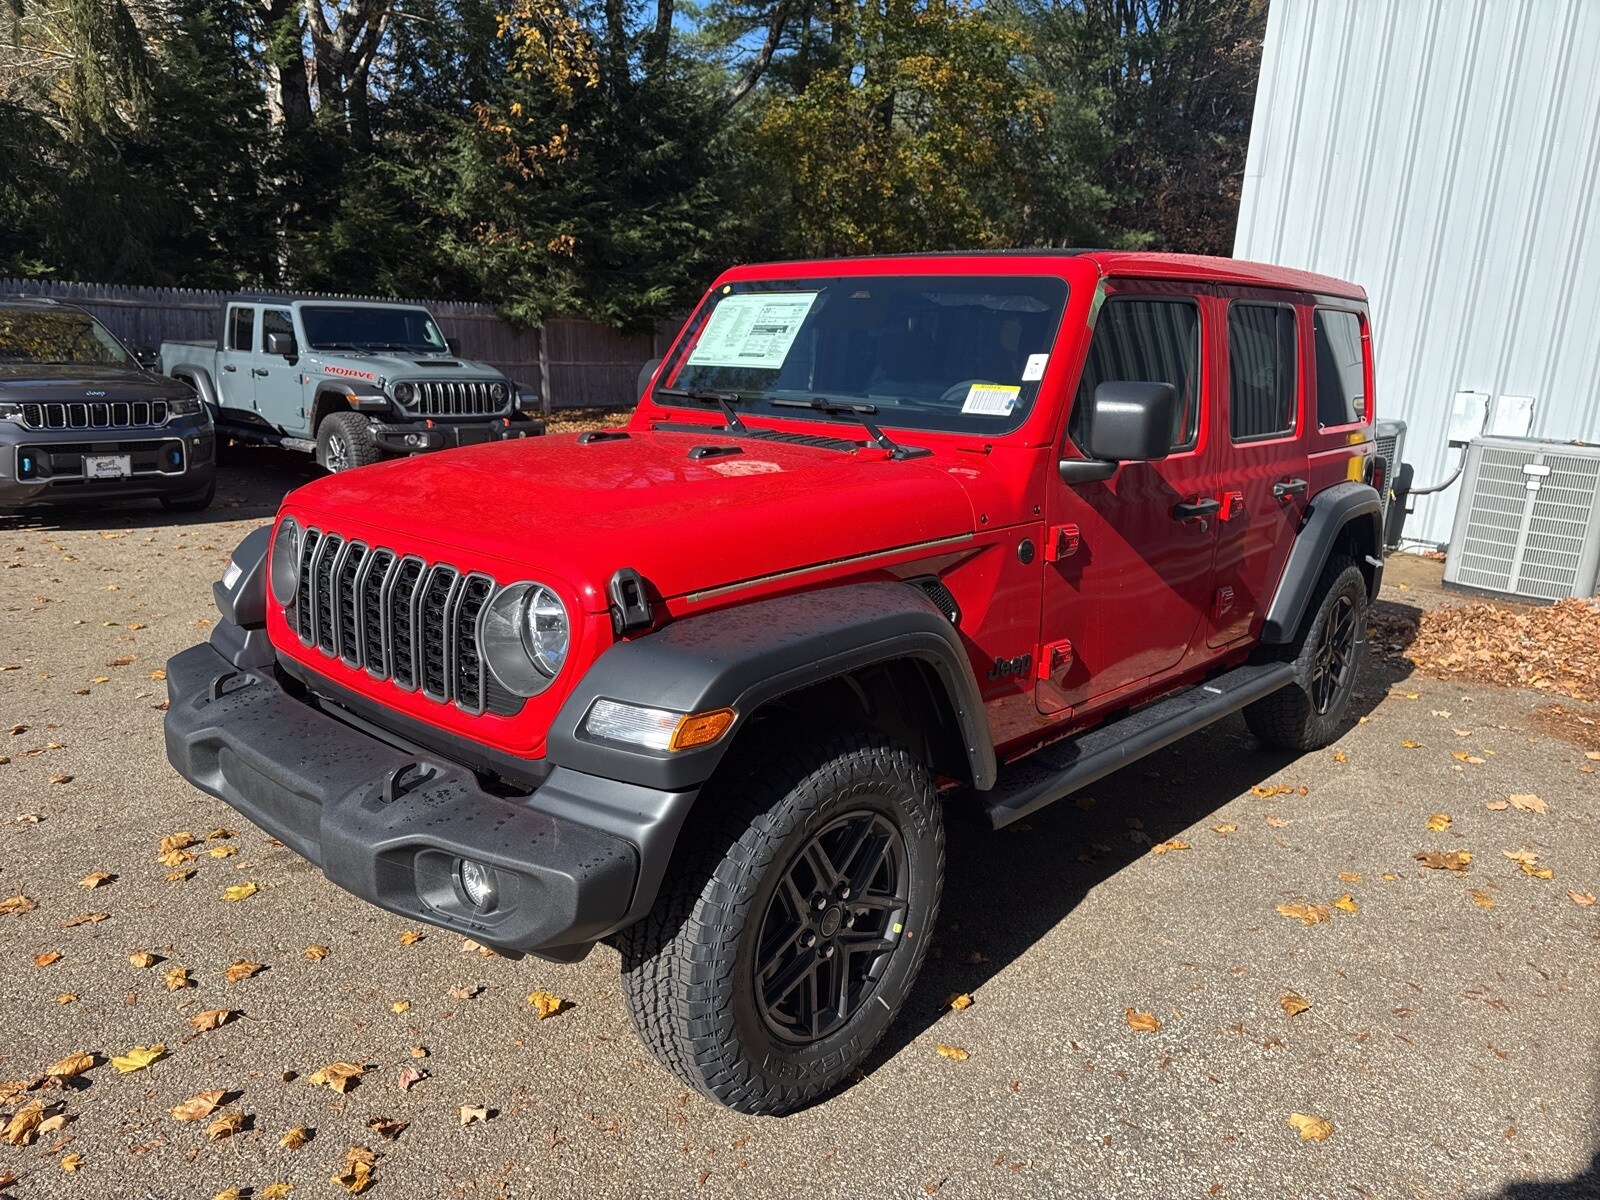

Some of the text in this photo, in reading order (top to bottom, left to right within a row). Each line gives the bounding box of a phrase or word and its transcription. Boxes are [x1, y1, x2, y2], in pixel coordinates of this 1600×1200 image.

[324, 366, 374, 379] MOJAVE
[988, 653, 1031, 680] Jeep
[762, 1035, 862, 1081] NEXEN
